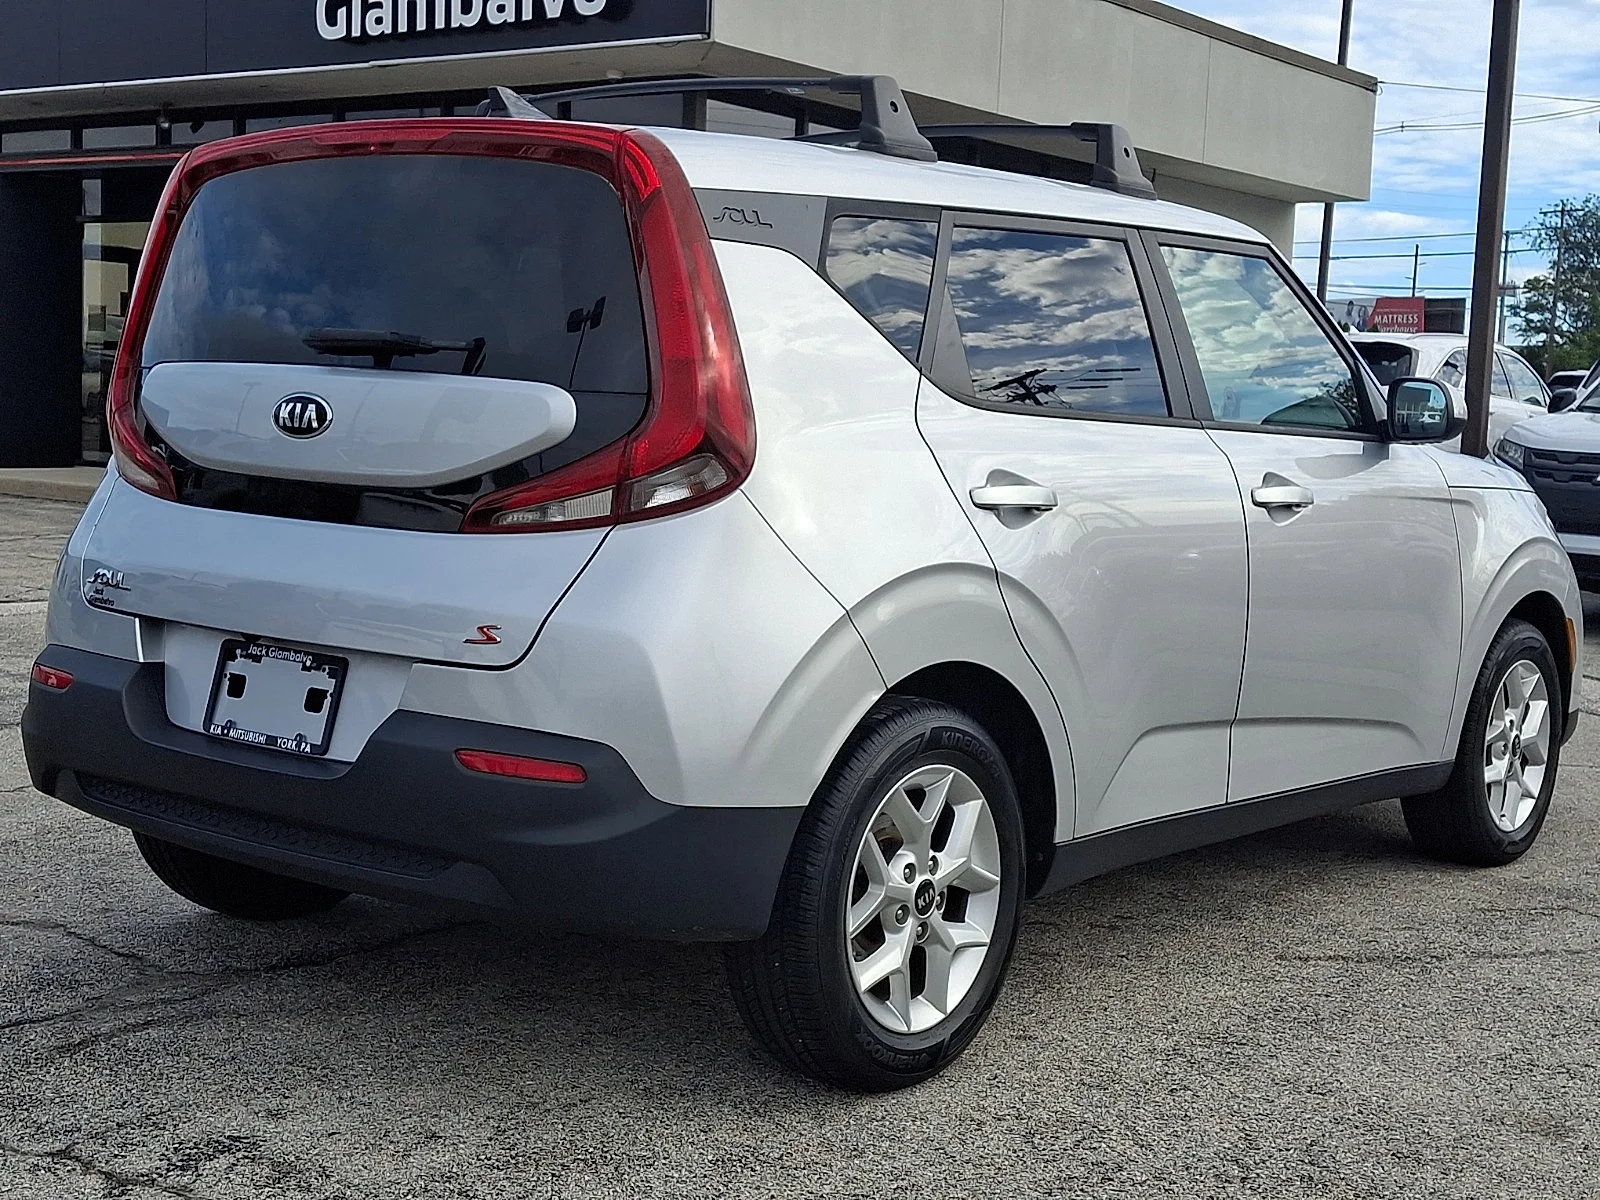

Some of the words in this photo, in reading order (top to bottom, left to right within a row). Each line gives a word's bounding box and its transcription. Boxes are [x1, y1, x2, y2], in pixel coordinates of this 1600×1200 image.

[1374, 313, 1419, 324] MATTRESS
[279, 402, 318, 428] KIA
[86, 568, 131, 591] SOUL
[463, 624, 502, 645] S
[248, 644, 267, 656] Jack
[210, 724, 222, 735] KIA
[229, 728, 267, 744] MITSUBISHI
[300, 742, 312, 754] PA
[917, 888, 935, 909] KIA
